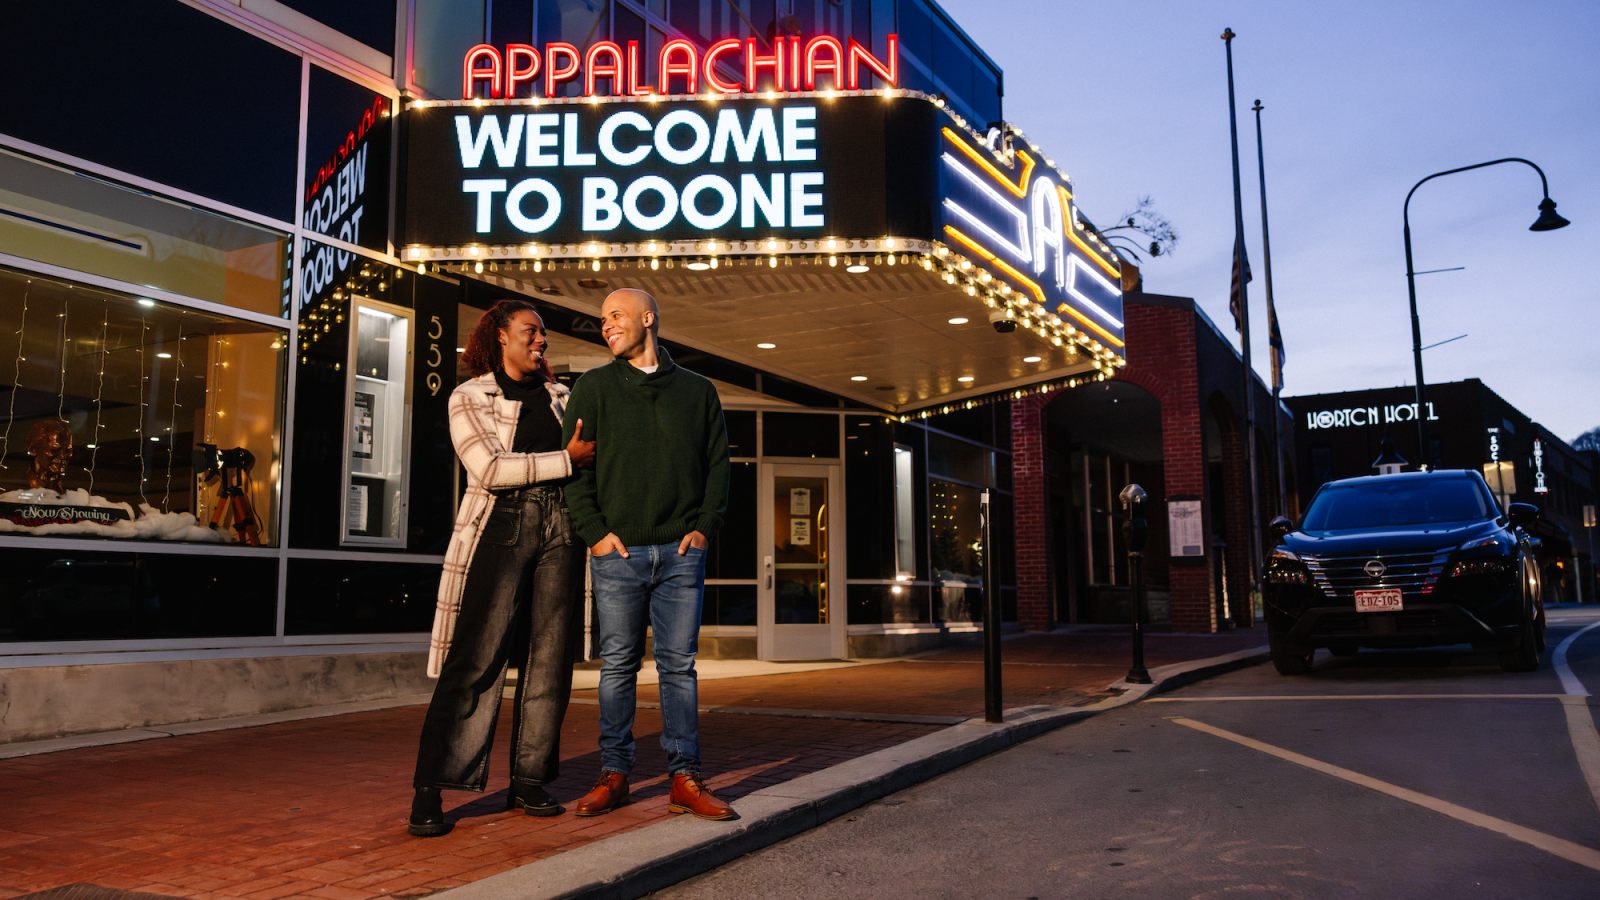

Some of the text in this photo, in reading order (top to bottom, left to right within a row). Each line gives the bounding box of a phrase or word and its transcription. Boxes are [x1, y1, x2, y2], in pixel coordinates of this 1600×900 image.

[463, 33, 898, 99] APPALACHIAN
[455, 106, 817, 168] WELCOME
[462, 172, 826, 233] TO BOONE
[1031, 175, 1066, 290] A
[426, 315, 443, 397] 559
[1384, 401, 1440, 424] HOTL
[15, 505, 57, 520] Now
[57, 506, 117, 522] Showing
